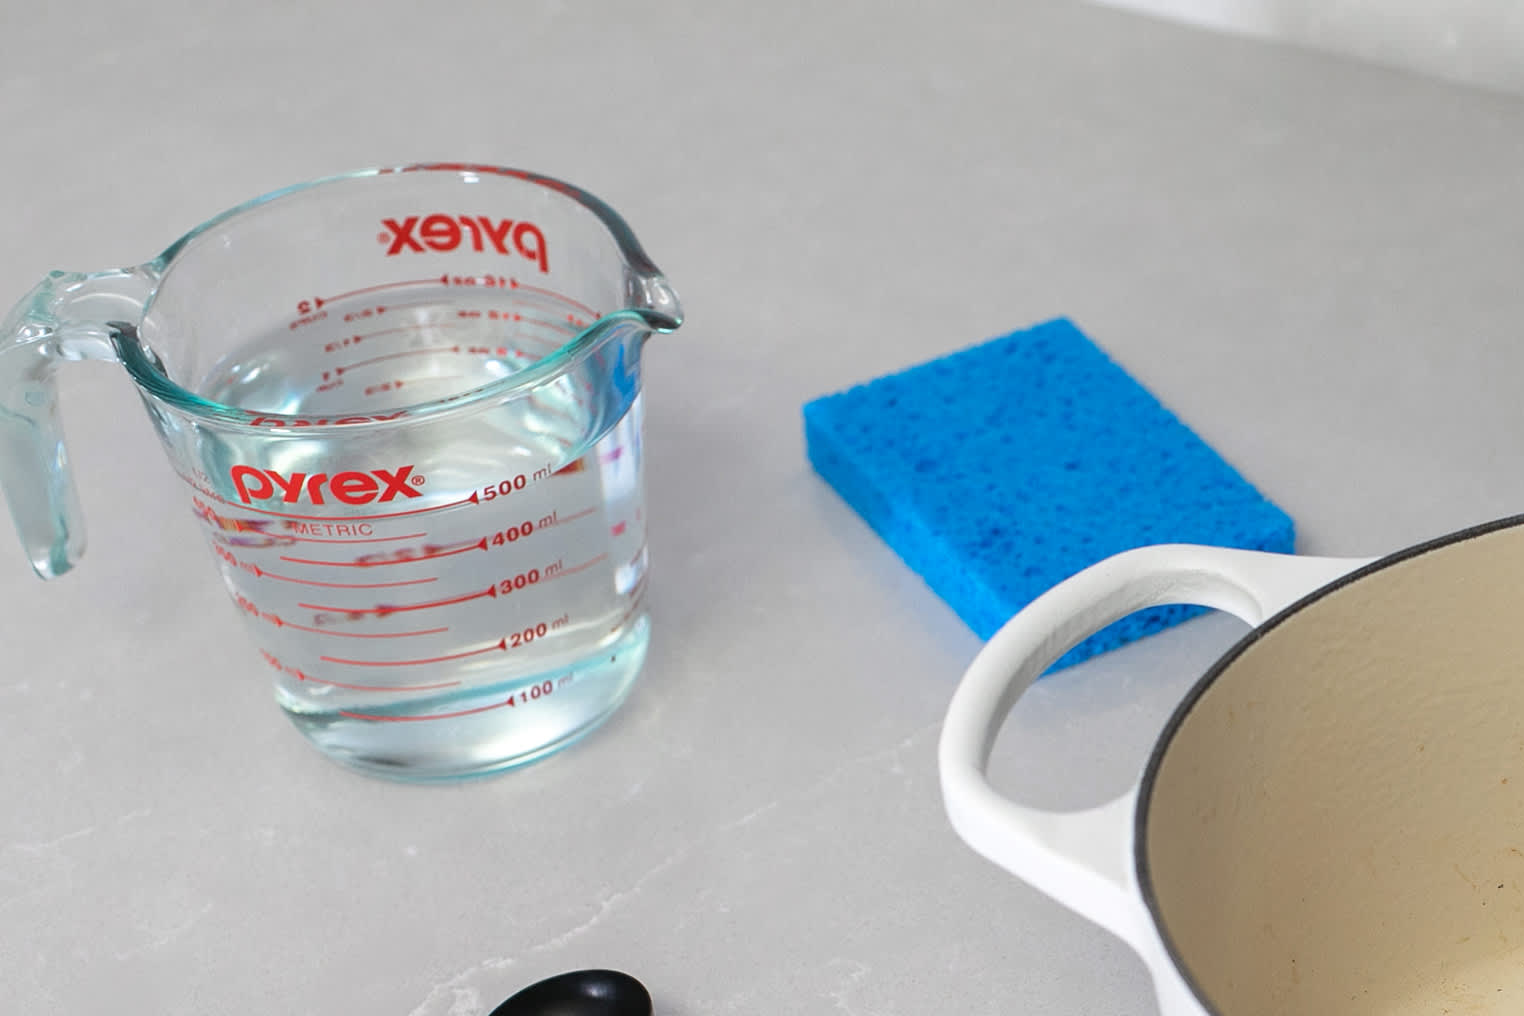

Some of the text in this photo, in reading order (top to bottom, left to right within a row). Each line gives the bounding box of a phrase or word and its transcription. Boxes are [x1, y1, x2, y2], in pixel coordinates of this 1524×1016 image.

[483, 463, 551, 501] 500 ml
[293, 522, 373, 537] METRIC
[492, 509, 557, 546] 400 ml
[500, 559, 563, 595] 300 ml
[511, 622, 547, 648] 200
[519, 680, 553, 703] 100
